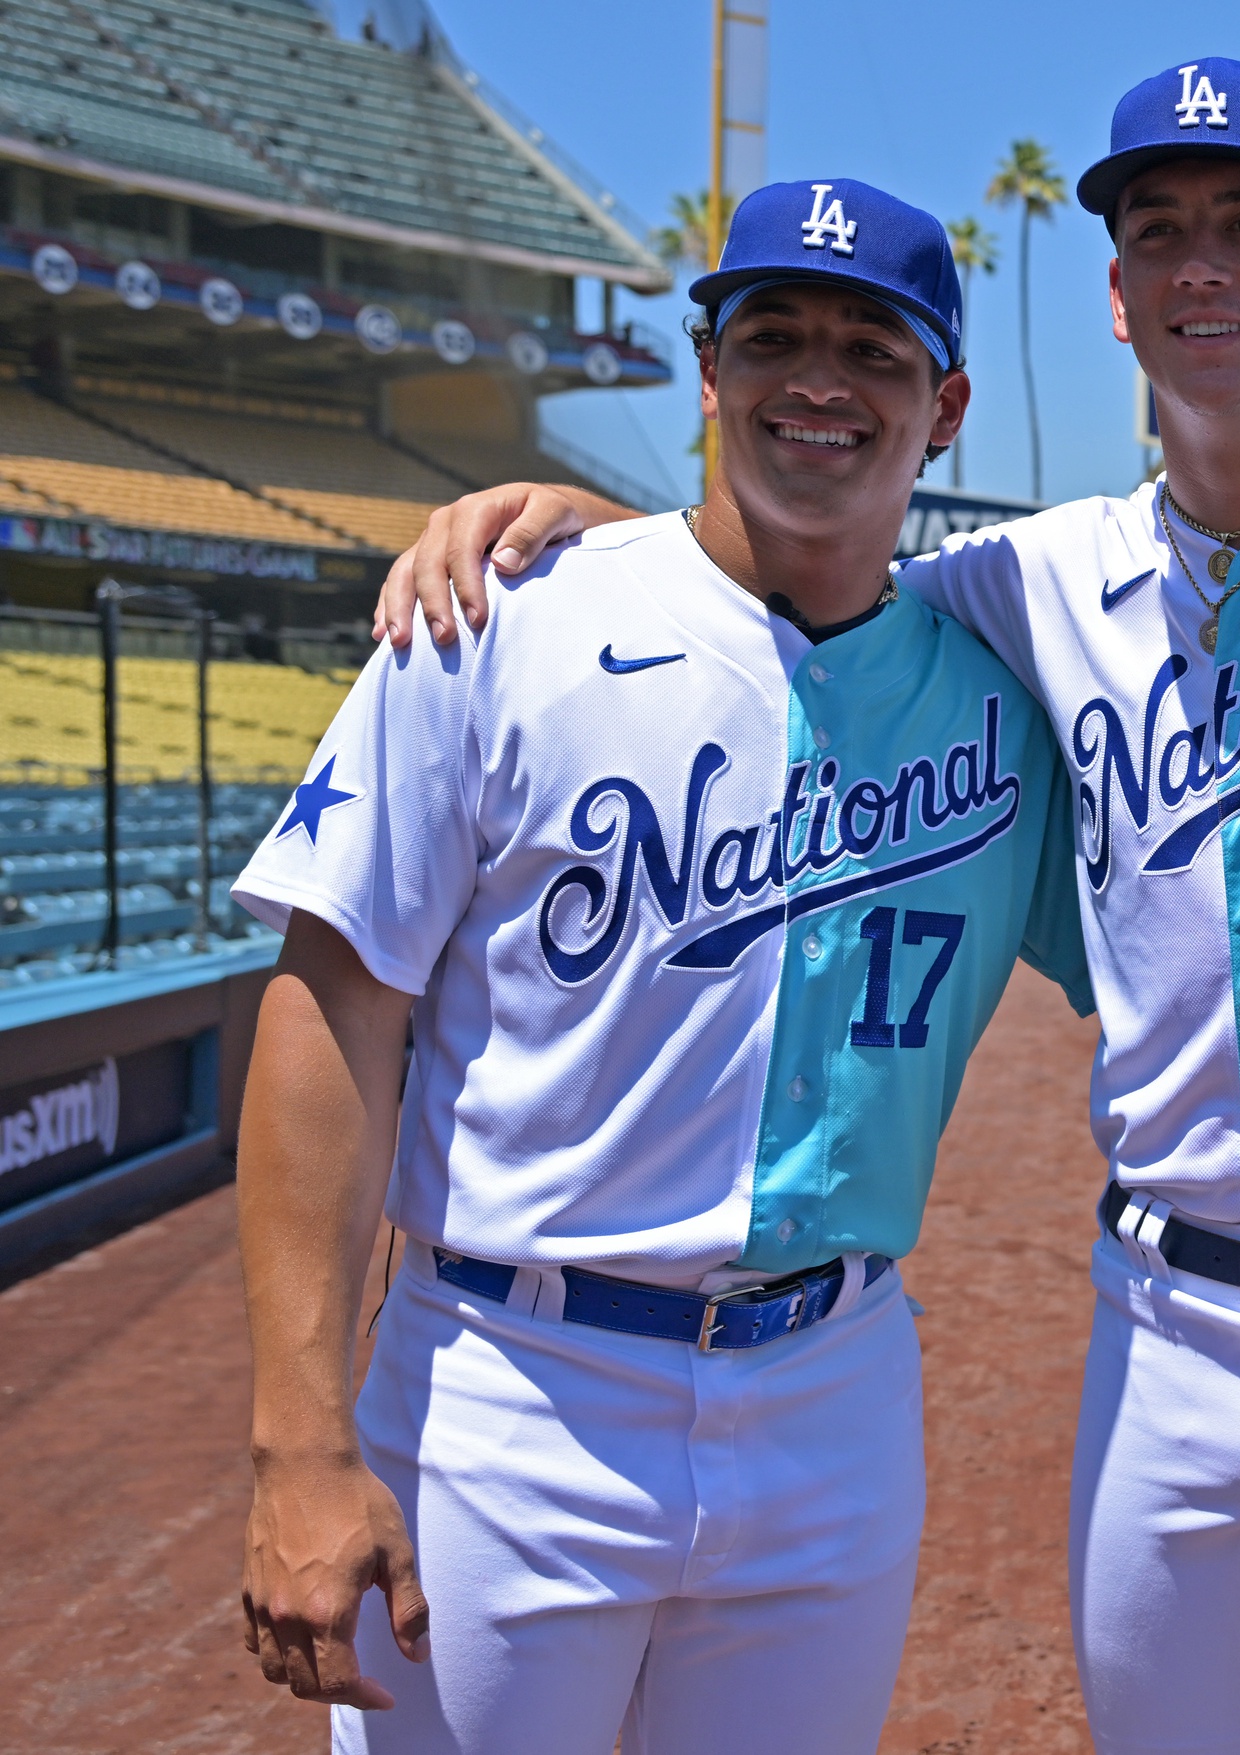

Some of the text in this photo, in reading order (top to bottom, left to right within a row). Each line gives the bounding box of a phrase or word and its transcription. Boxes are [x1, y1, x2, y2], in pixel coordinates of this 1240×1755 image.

[1174, 64, 1229, 127] LA
[801, 184, 858, 255] LA
[536, 692, 1021, 988] National
[849, 905, 967, 1049] 17
